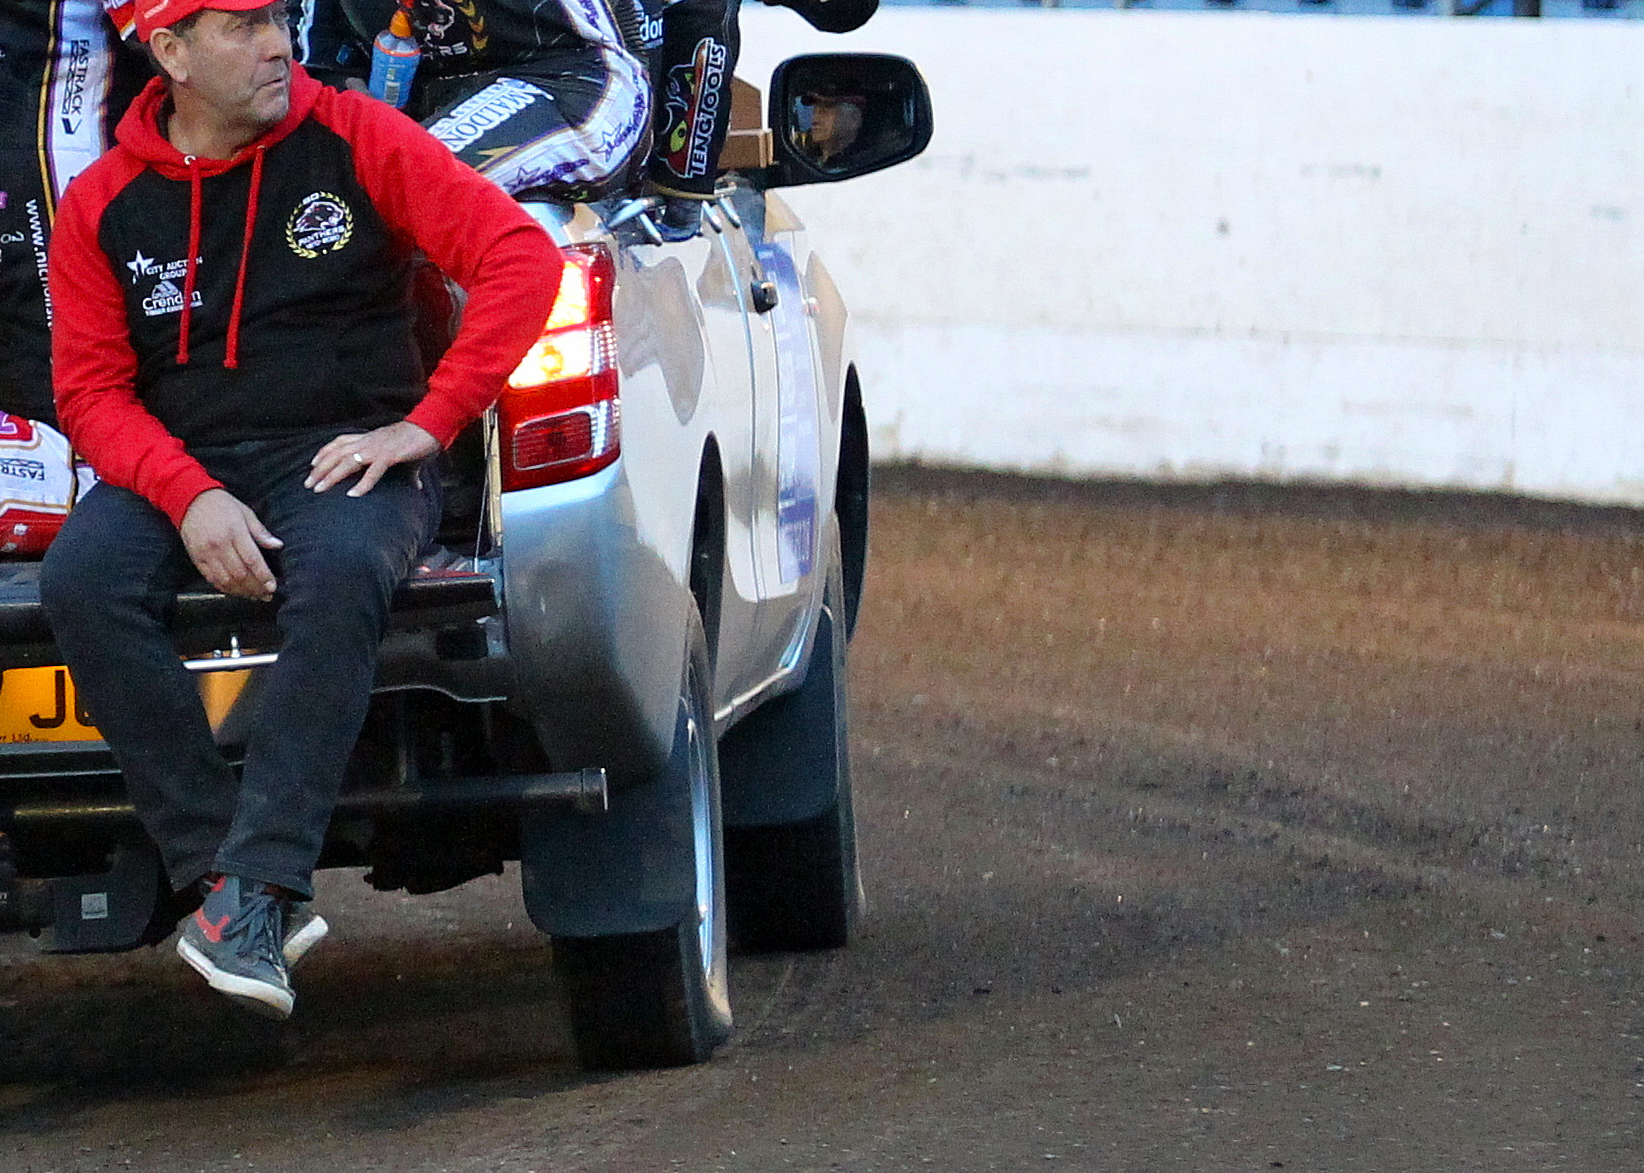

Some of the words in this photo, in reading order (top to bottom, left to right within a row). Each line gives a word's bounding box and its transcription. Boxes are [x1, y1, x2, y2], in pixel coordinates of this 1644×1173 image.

[71, 39, 89, 116] FASTRACK
[446, 89, 536, 150] MALDON
[142, 291, 202, 311] Crendn
